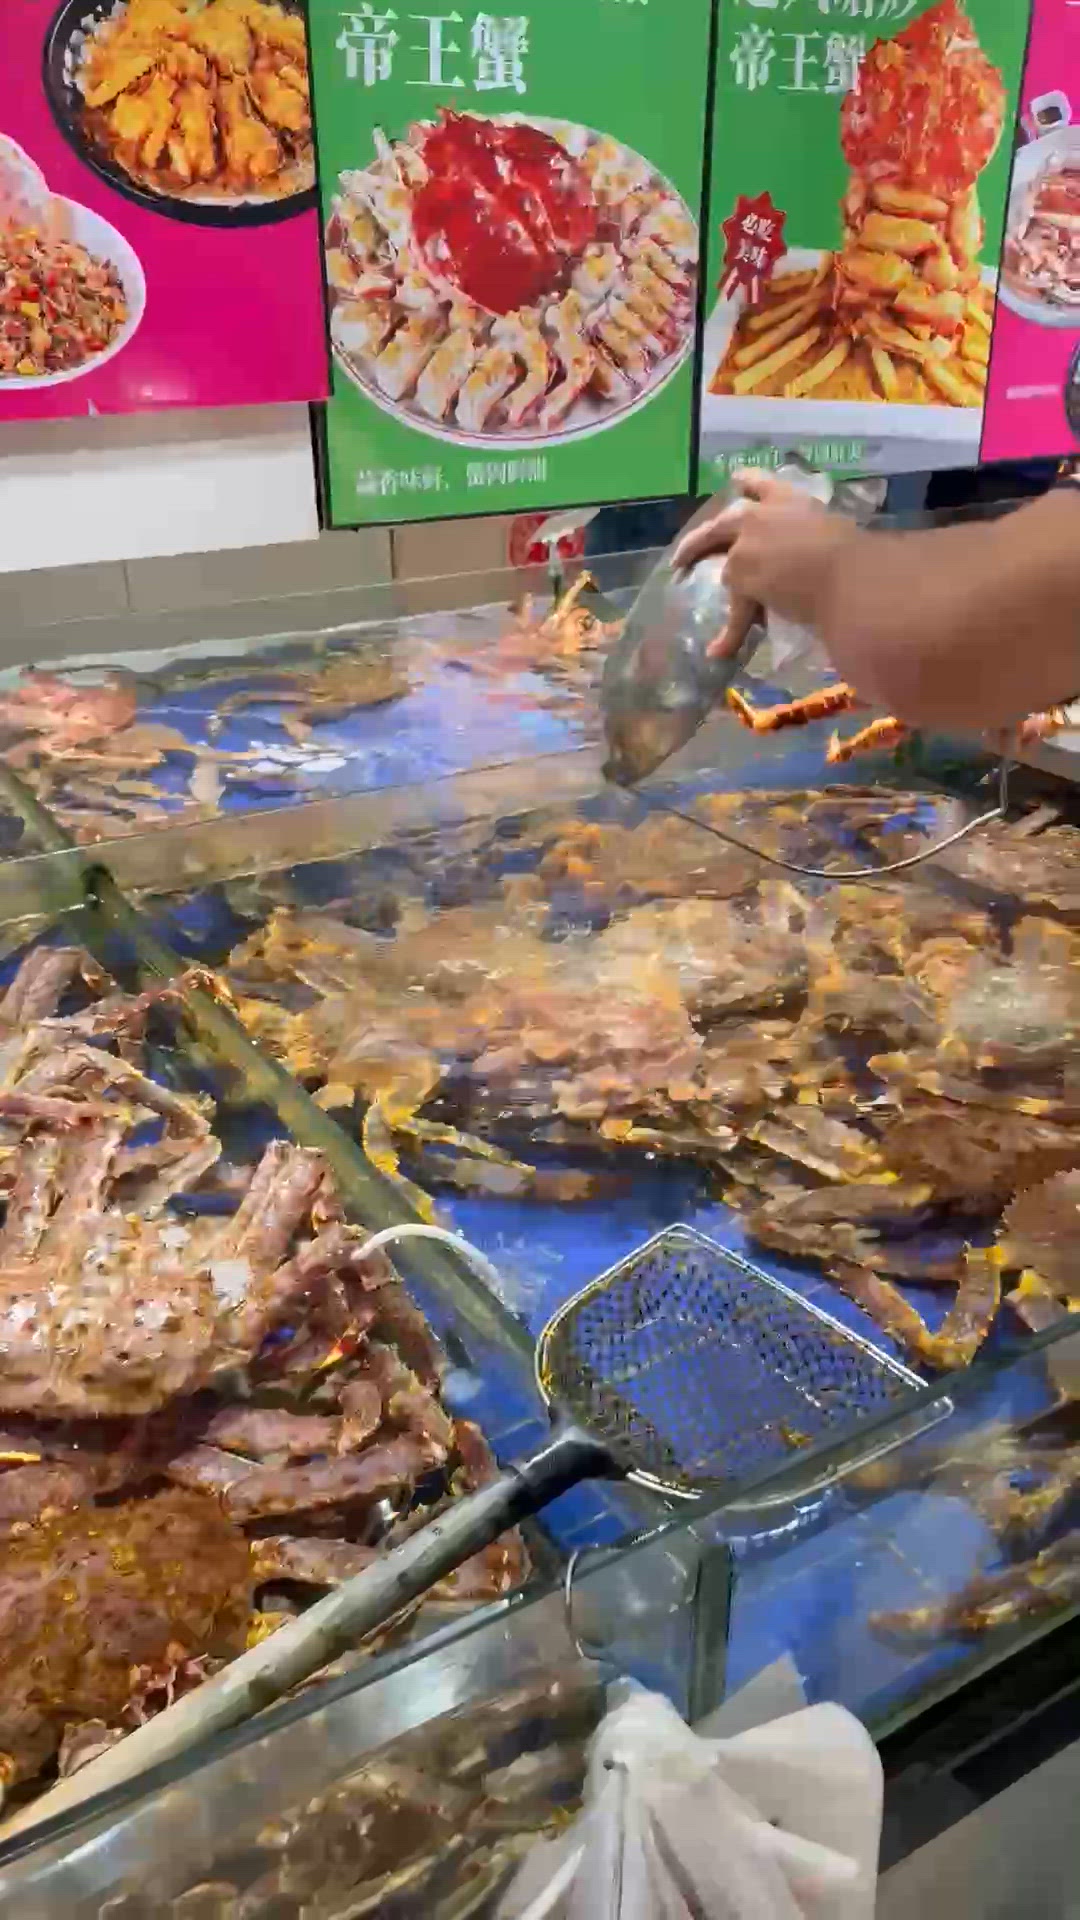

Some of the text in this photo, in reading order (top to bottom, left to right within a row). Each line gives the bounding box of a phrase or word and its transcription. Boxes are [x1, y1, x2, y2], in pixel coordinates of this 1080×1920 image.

[336, 2, 529, 95] 帝王蟹
[730, 24, 866, 95] 帝王蟹
